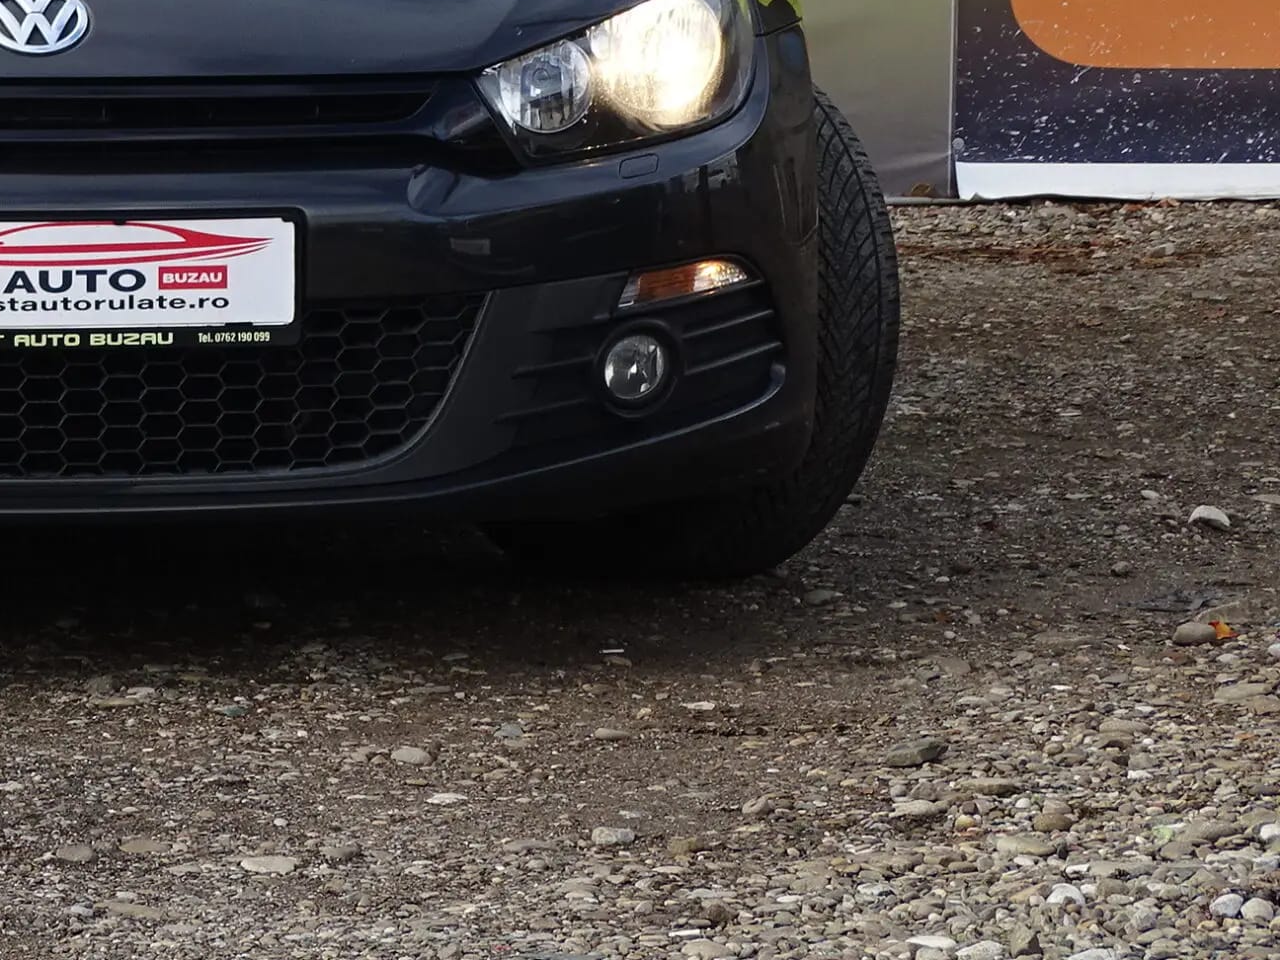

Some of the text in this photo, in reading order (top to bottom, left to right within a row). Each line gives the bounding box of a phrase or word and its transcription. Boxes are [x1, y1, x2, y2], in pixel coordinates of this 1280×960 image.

[3, 269, 147, 293] AUTO
[162, 271, 223, 284] BUZAU
[13, 333, 81, 347] AUTO
[89, 332, 174, 346] BUZAU
[198, 331, 270, 343] Tel. 0762 190 099
